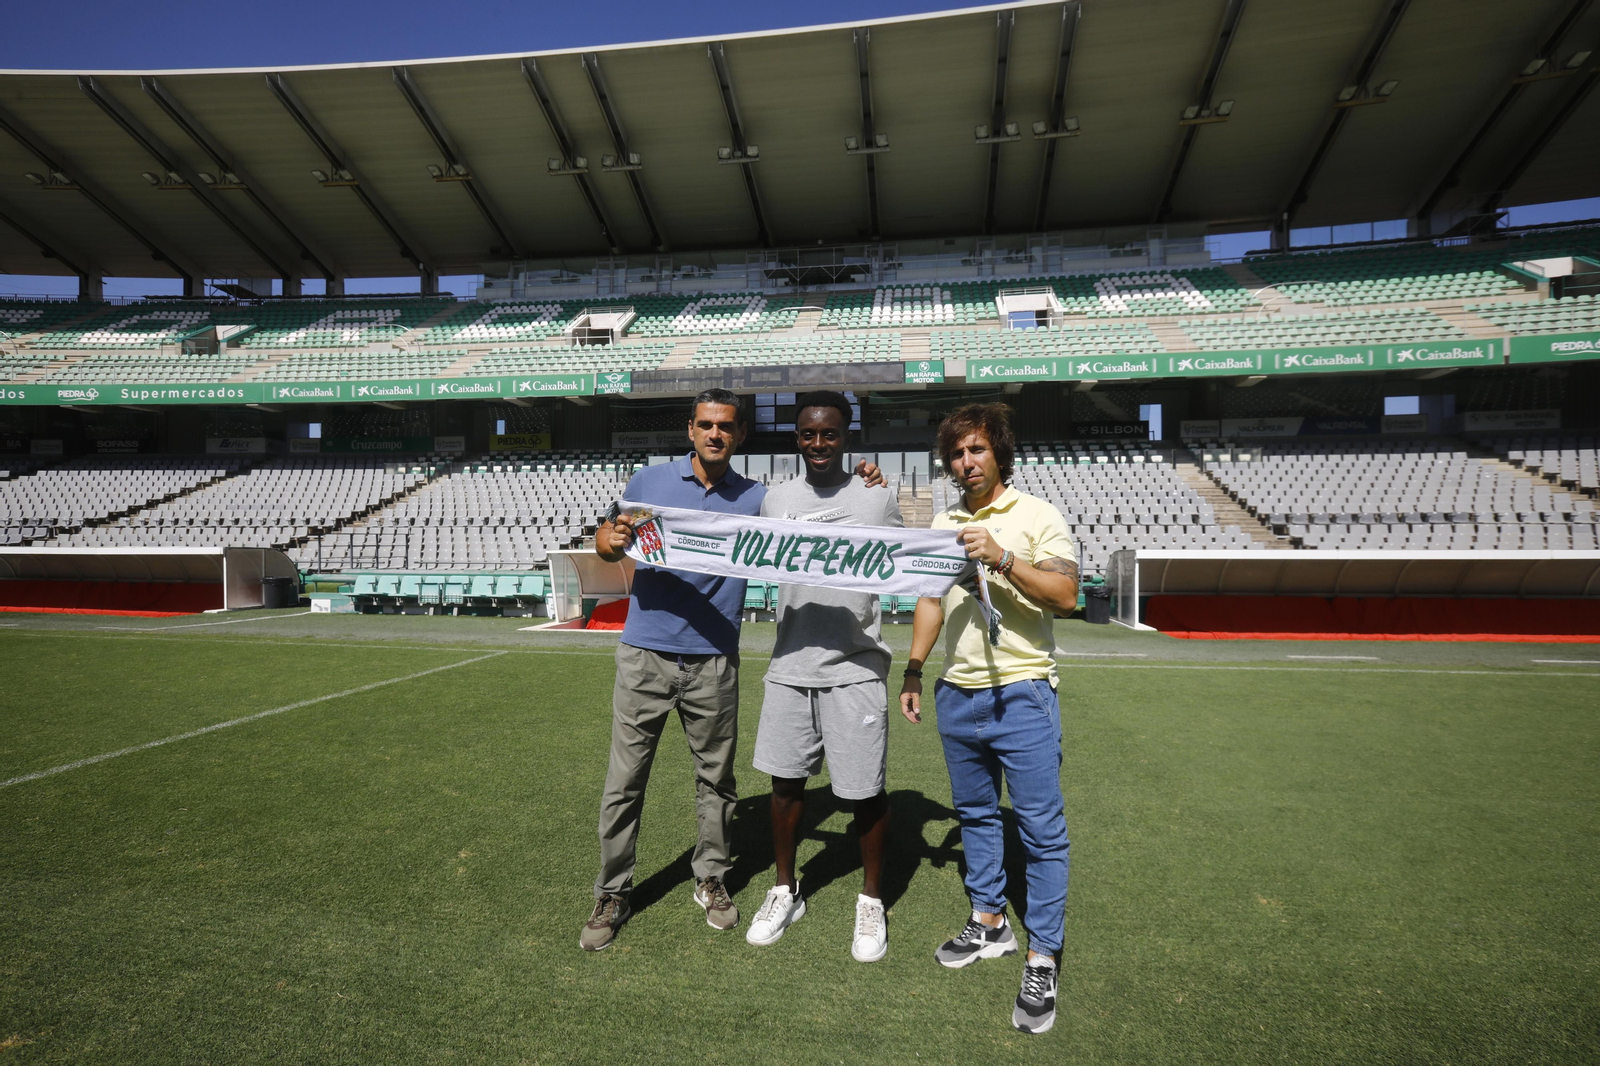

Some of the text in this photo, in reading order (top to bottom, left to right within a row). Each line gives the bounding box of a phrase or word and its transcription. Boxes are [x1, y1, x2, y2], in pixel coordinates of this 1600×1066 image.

[1551, 341, 1595, 351] PIEDRA
[1415, 346, 1484, 361] CaixaBank
[1194, 357, 1254, 370] CaixaBank
[1301, 353, 1365, 366] CaixaBank
[995, 365, 1049, 376] CaixaBank
[1093, 361, 1149, 373] CaixaBank
[370, 385, 413, 396] CaixaBank
[450, 382, 494, 394] CaixaBank
[533, 381, 578, 391] CaixaBank
[58, 389, 86, 398] PIEDRA
[121, 387, 244, 401] Supermercados
[291, 387, 334, 397] CaixaBank
[1091, 425, 1144, 435] SILBON
[96, 440, 140, 448] SOFASS
[351, 440, 403, 451] Cruzcampo
[497, 437, 527, 446] PIEDRA
[711, 542, 721, 550] CF
[731, 529, 902, 580] VOLVEREMOS
[952, 563, 964, 571] CF
